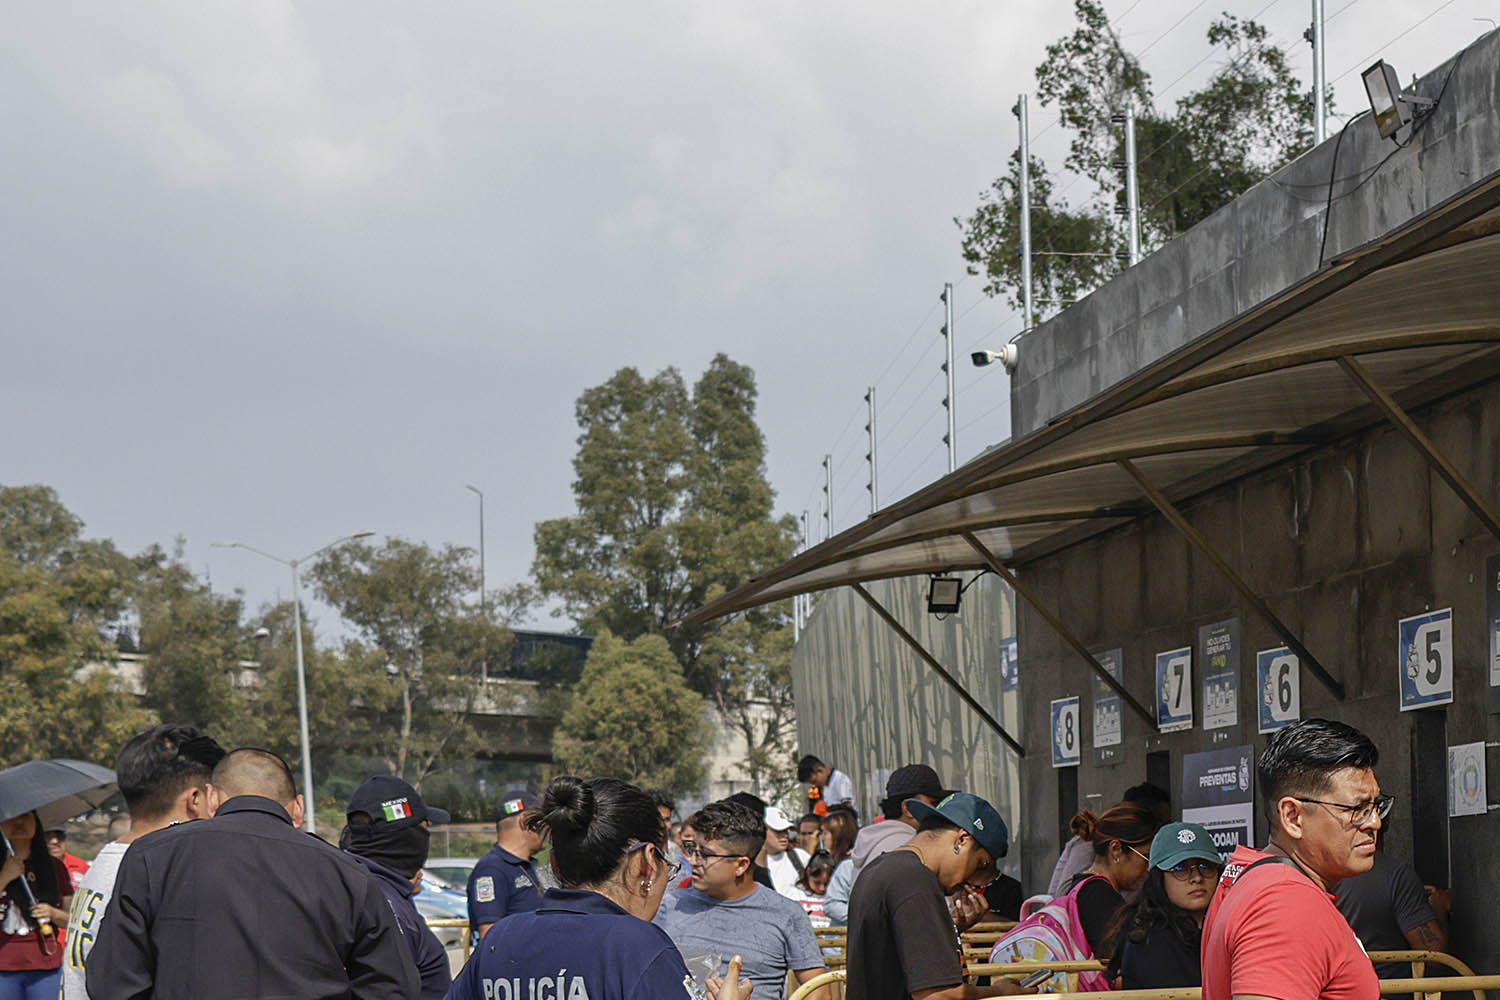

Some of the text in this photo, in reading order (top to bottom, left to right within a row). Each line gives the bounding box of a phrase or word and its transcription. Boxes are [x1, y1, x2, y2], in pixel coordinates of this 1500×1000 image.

[1426, 630, 1442, 685] 5
[1174, 664, 1184, 708] 7
[1279, 663, 1292, 712] 6
[1065, 711, 1074, 750] 8
[1200, 772, 1237, 788] PREVENTAS
